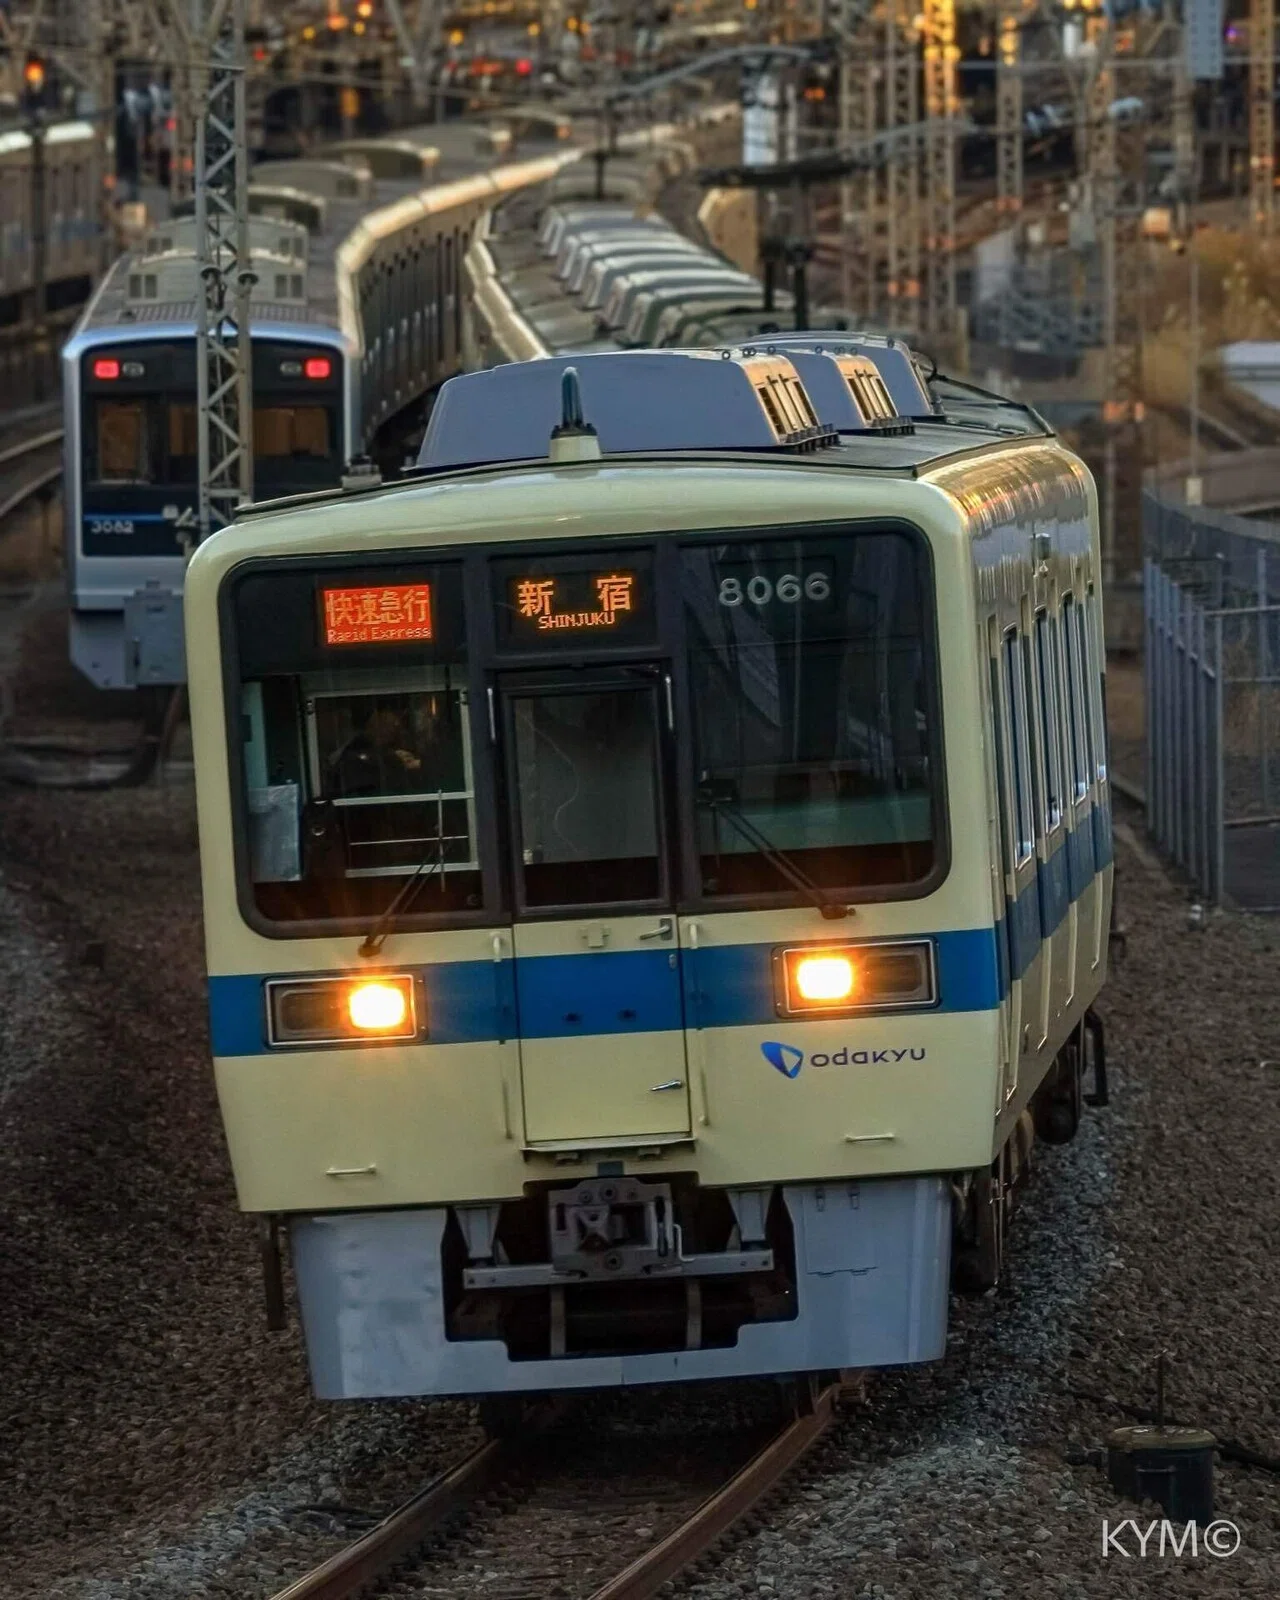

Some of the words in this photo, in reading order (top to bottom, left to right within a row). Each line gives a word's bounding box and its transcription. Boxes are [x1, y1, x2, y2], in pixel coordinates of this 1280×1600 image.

[719, 572, 830, 606] 8066
[327, 589, 429, 627] 快速急行
[539, 611, 615, 629] SHINJUKU
[328, 629, 367, 643] Rapid
[371, 627, 432, 640] Express
[810, 1047, 926, 1067] odakyu
